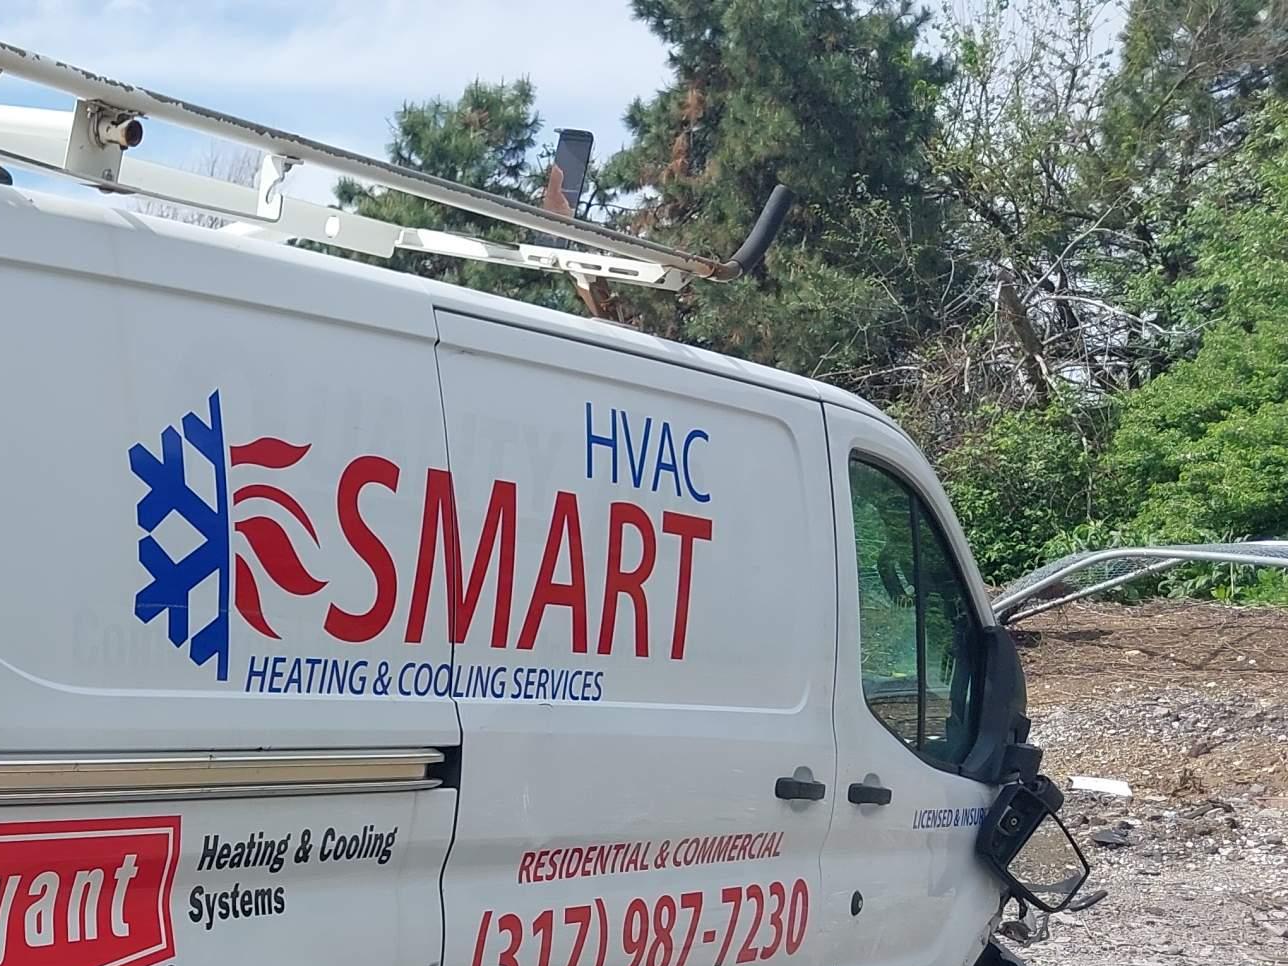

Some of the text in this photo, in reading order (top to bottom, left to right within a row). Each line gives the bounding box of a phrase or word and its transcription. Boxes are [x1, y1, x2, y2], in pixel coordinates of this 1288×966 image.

[586, 402, 710, 503] HVAC
[323, 455, 713, 661] SMART
[245, 656, 604, 702] HEATING & COOLING SERVICES
[912, 807, 985, 830] LICENSED & INSUR
[197, 825, 399, 874] Heating & Cooling
[518, 831, 784, 884] RESIDENTIAL & COMMERCIAL
[188, 883, 286, 930] Systems
